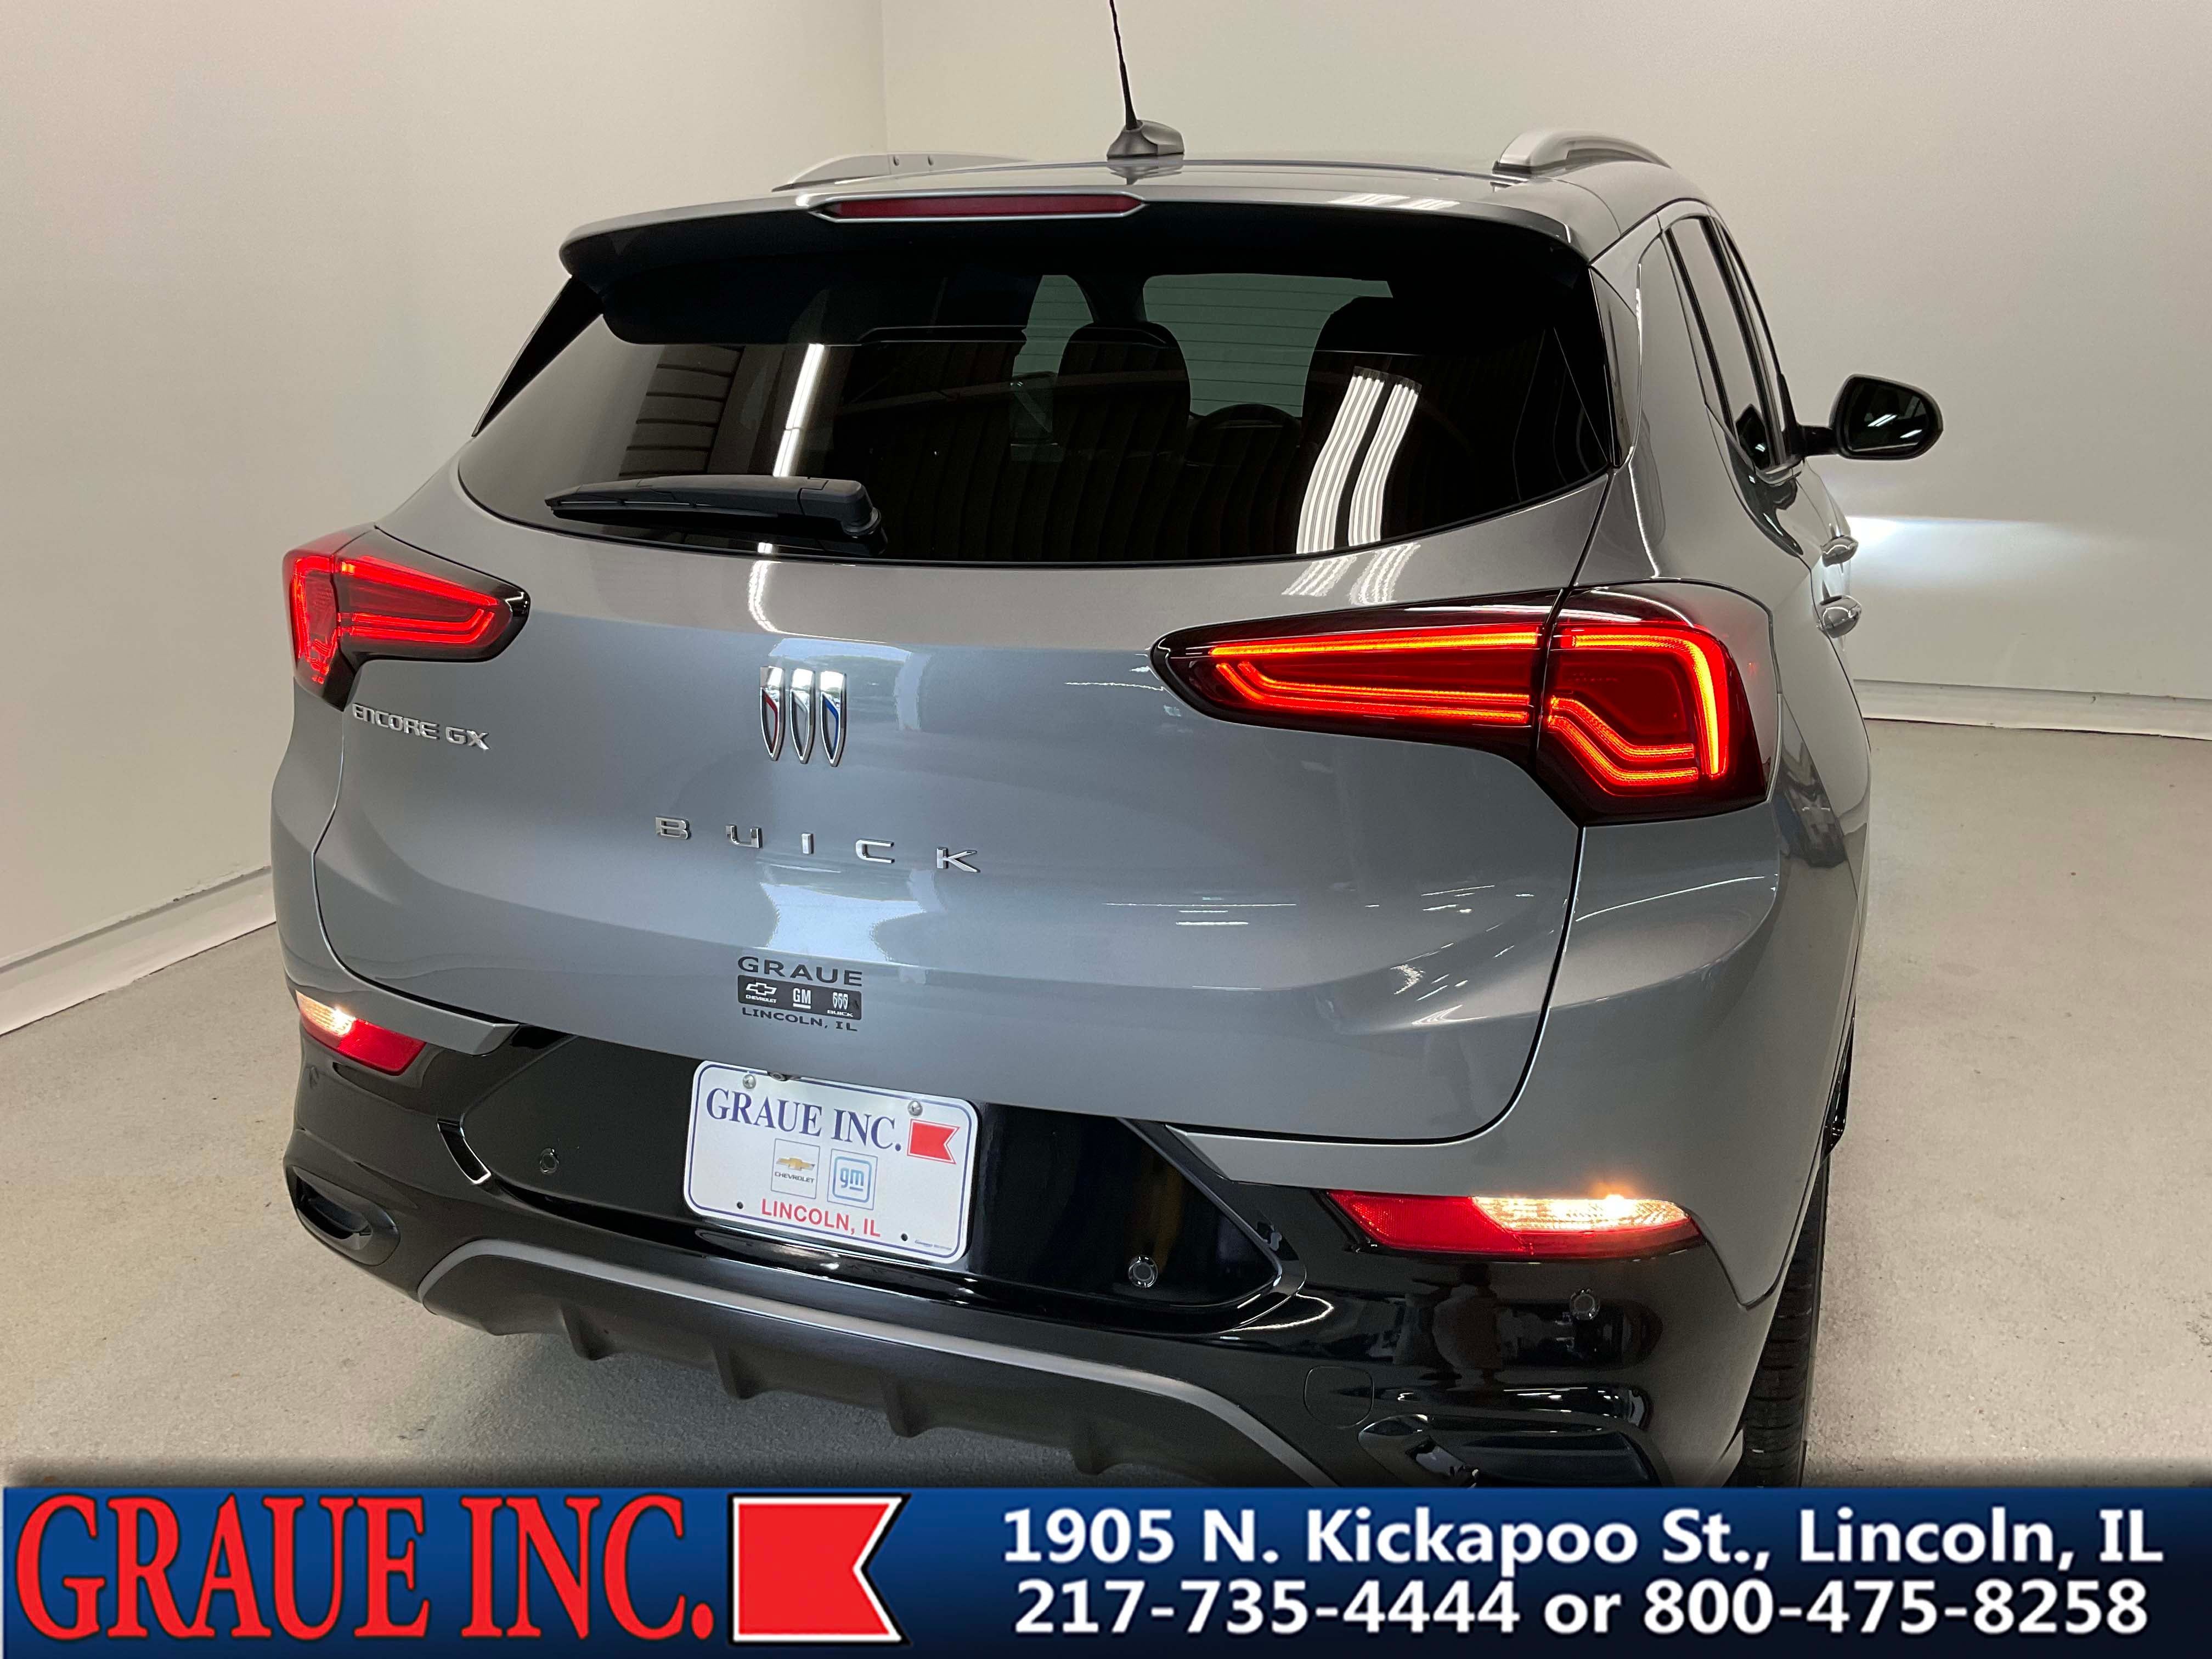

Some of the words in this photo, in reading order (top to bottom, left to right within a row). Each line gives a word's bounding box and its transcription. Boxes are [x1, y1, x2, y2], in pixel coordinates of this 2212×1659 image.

[352, 703, 439, 740] ENCORE
[445, 726, 489, 750] GX
[656, 816, 981, 873] BUICK
[738, 956, 862, 986] GRAUE
[746, 995, 777, 1003] CHEVROLET
[793, 988, 811, 1005] GM
[742, 1007, 828, 1029] LINCOLN,
[836, 1021, 857, 1031] IL
[706, 1088, 822, 1137] GRAUE
[831, 1108, 901, 1152] INC.
[775, 1171, 815, 1183] CHEVROLET
[840, 1167, 865, 1189] gm
[761, 1198, 855, 1235] LINCOLN,
[864, 1218, 881, 1237] IL
